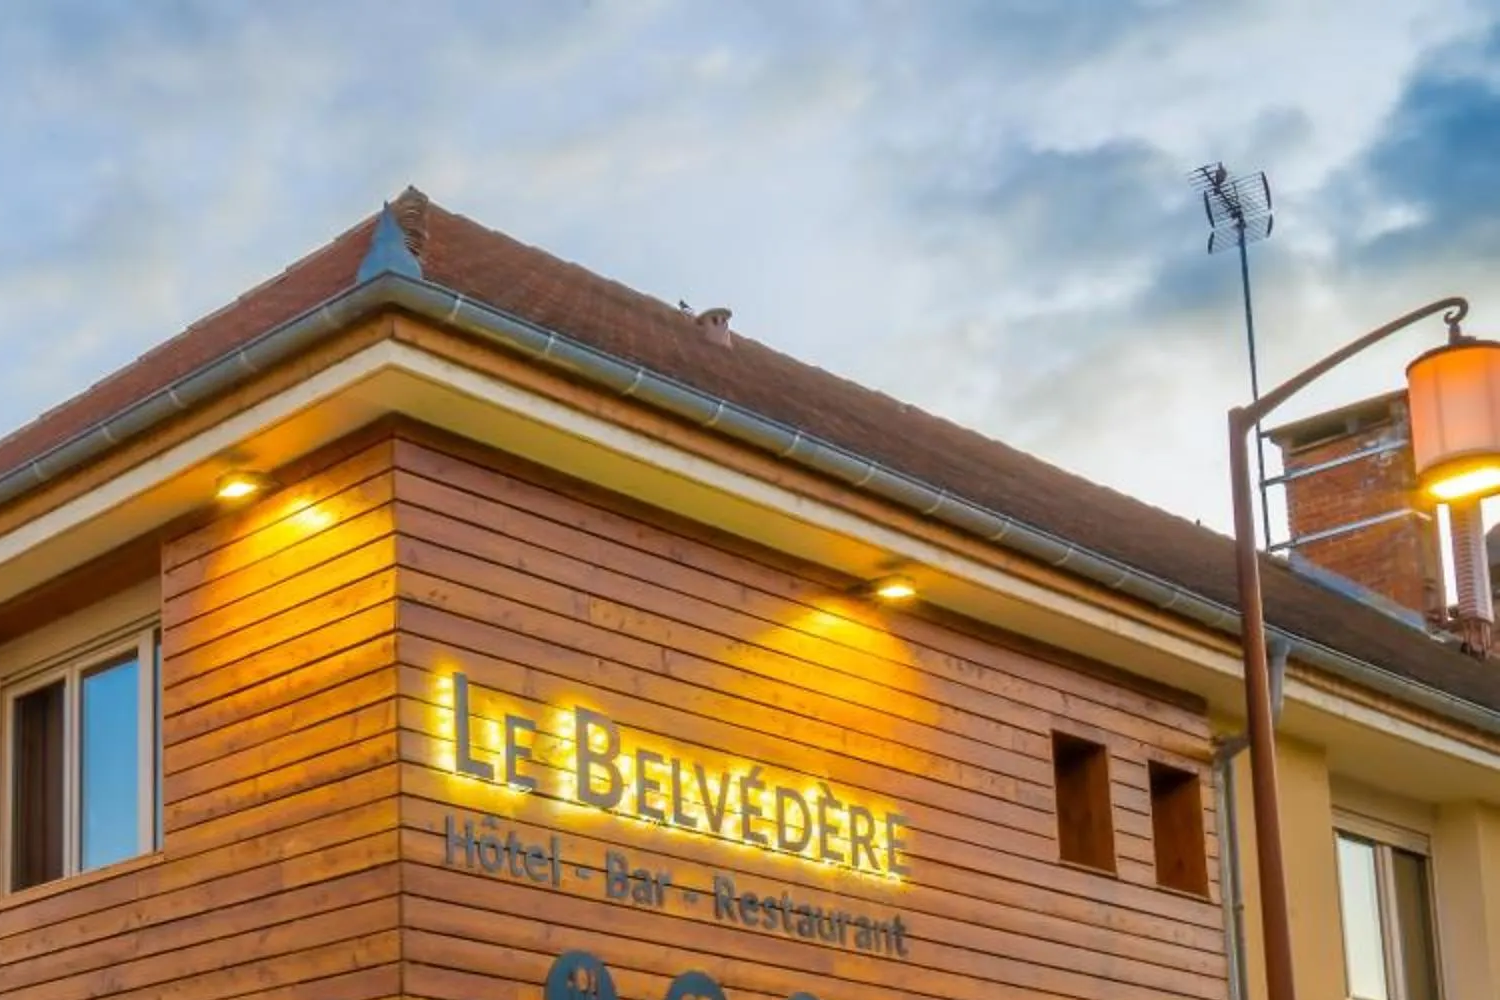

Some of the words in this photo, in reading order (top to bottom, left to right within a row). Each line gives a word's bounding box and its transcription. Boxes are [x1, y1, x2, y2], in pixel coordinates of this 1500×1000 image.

[453, 672, 538, 792] LE
[575, 706, 910, 876] BELVÉDÈRE
[445, 814, 561, 887] Hôtel
[605, 850, 671, 907] Bar
[713, 874, 909, 957] Restaurant
